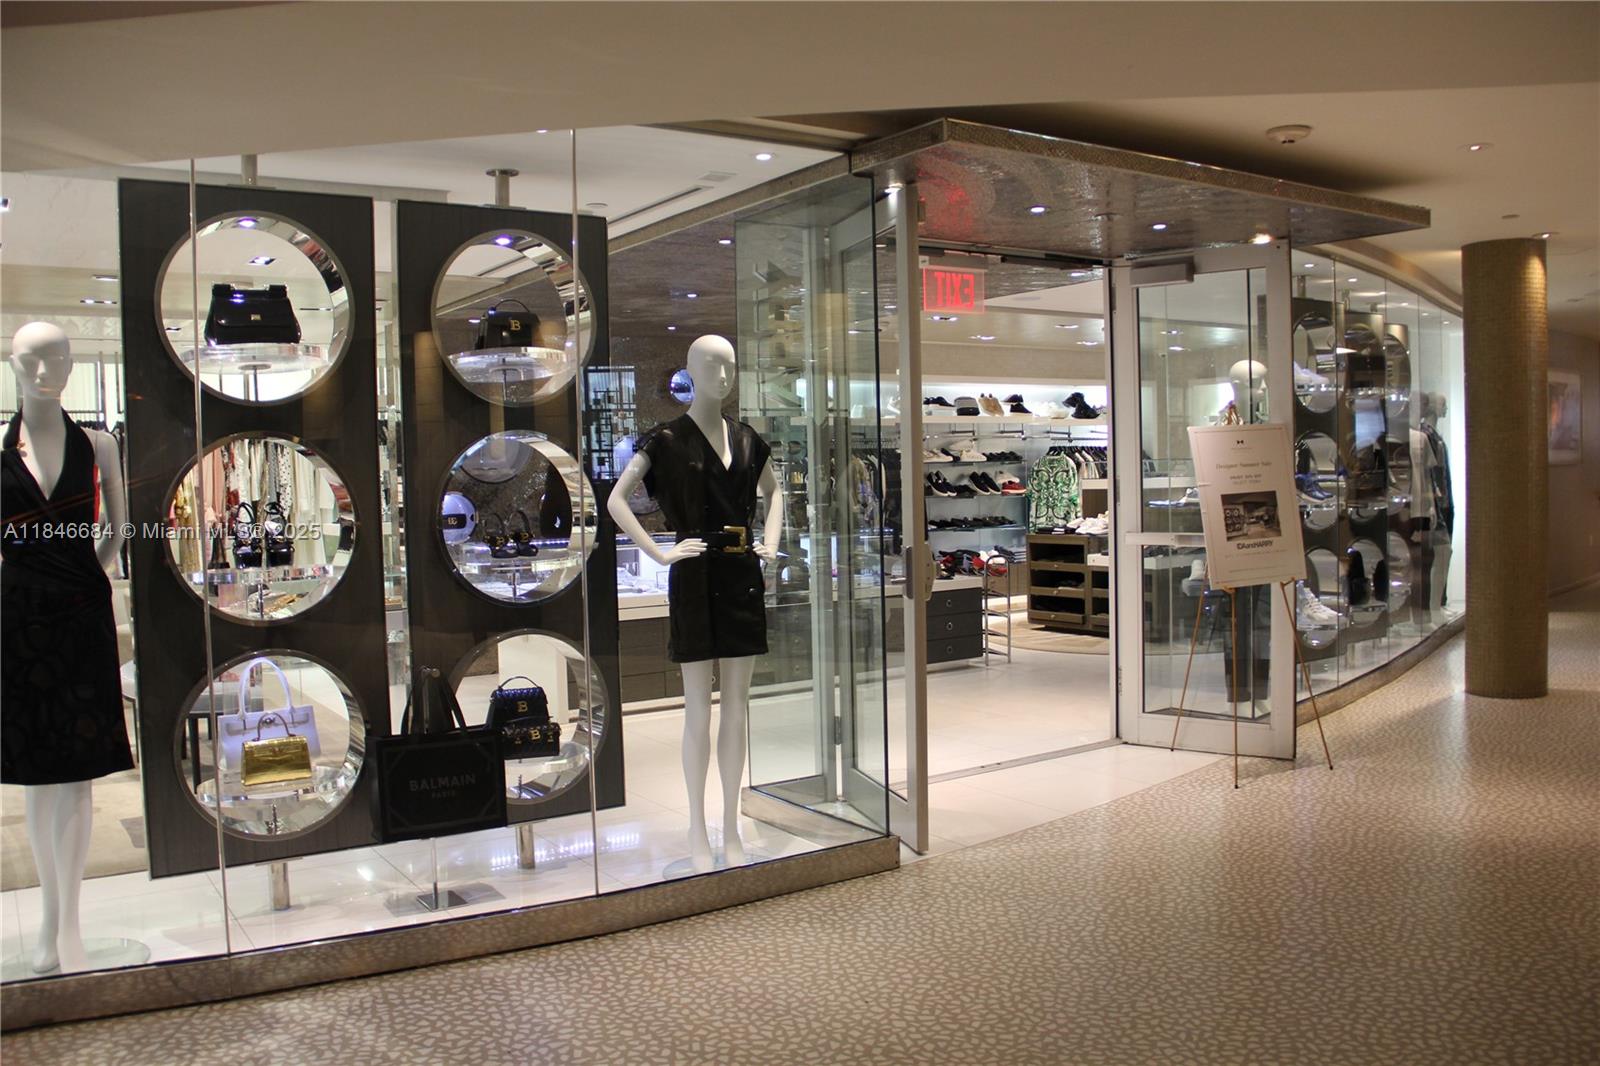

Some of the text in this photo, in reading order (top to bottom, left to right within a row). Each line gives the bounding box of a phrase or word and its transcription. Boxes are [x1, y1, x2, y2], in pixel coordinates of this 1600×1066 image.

[517, 701, 528, 713] B
[530, 728, 541, 741] B
[408, 773, 477, 792] BALMAIN
